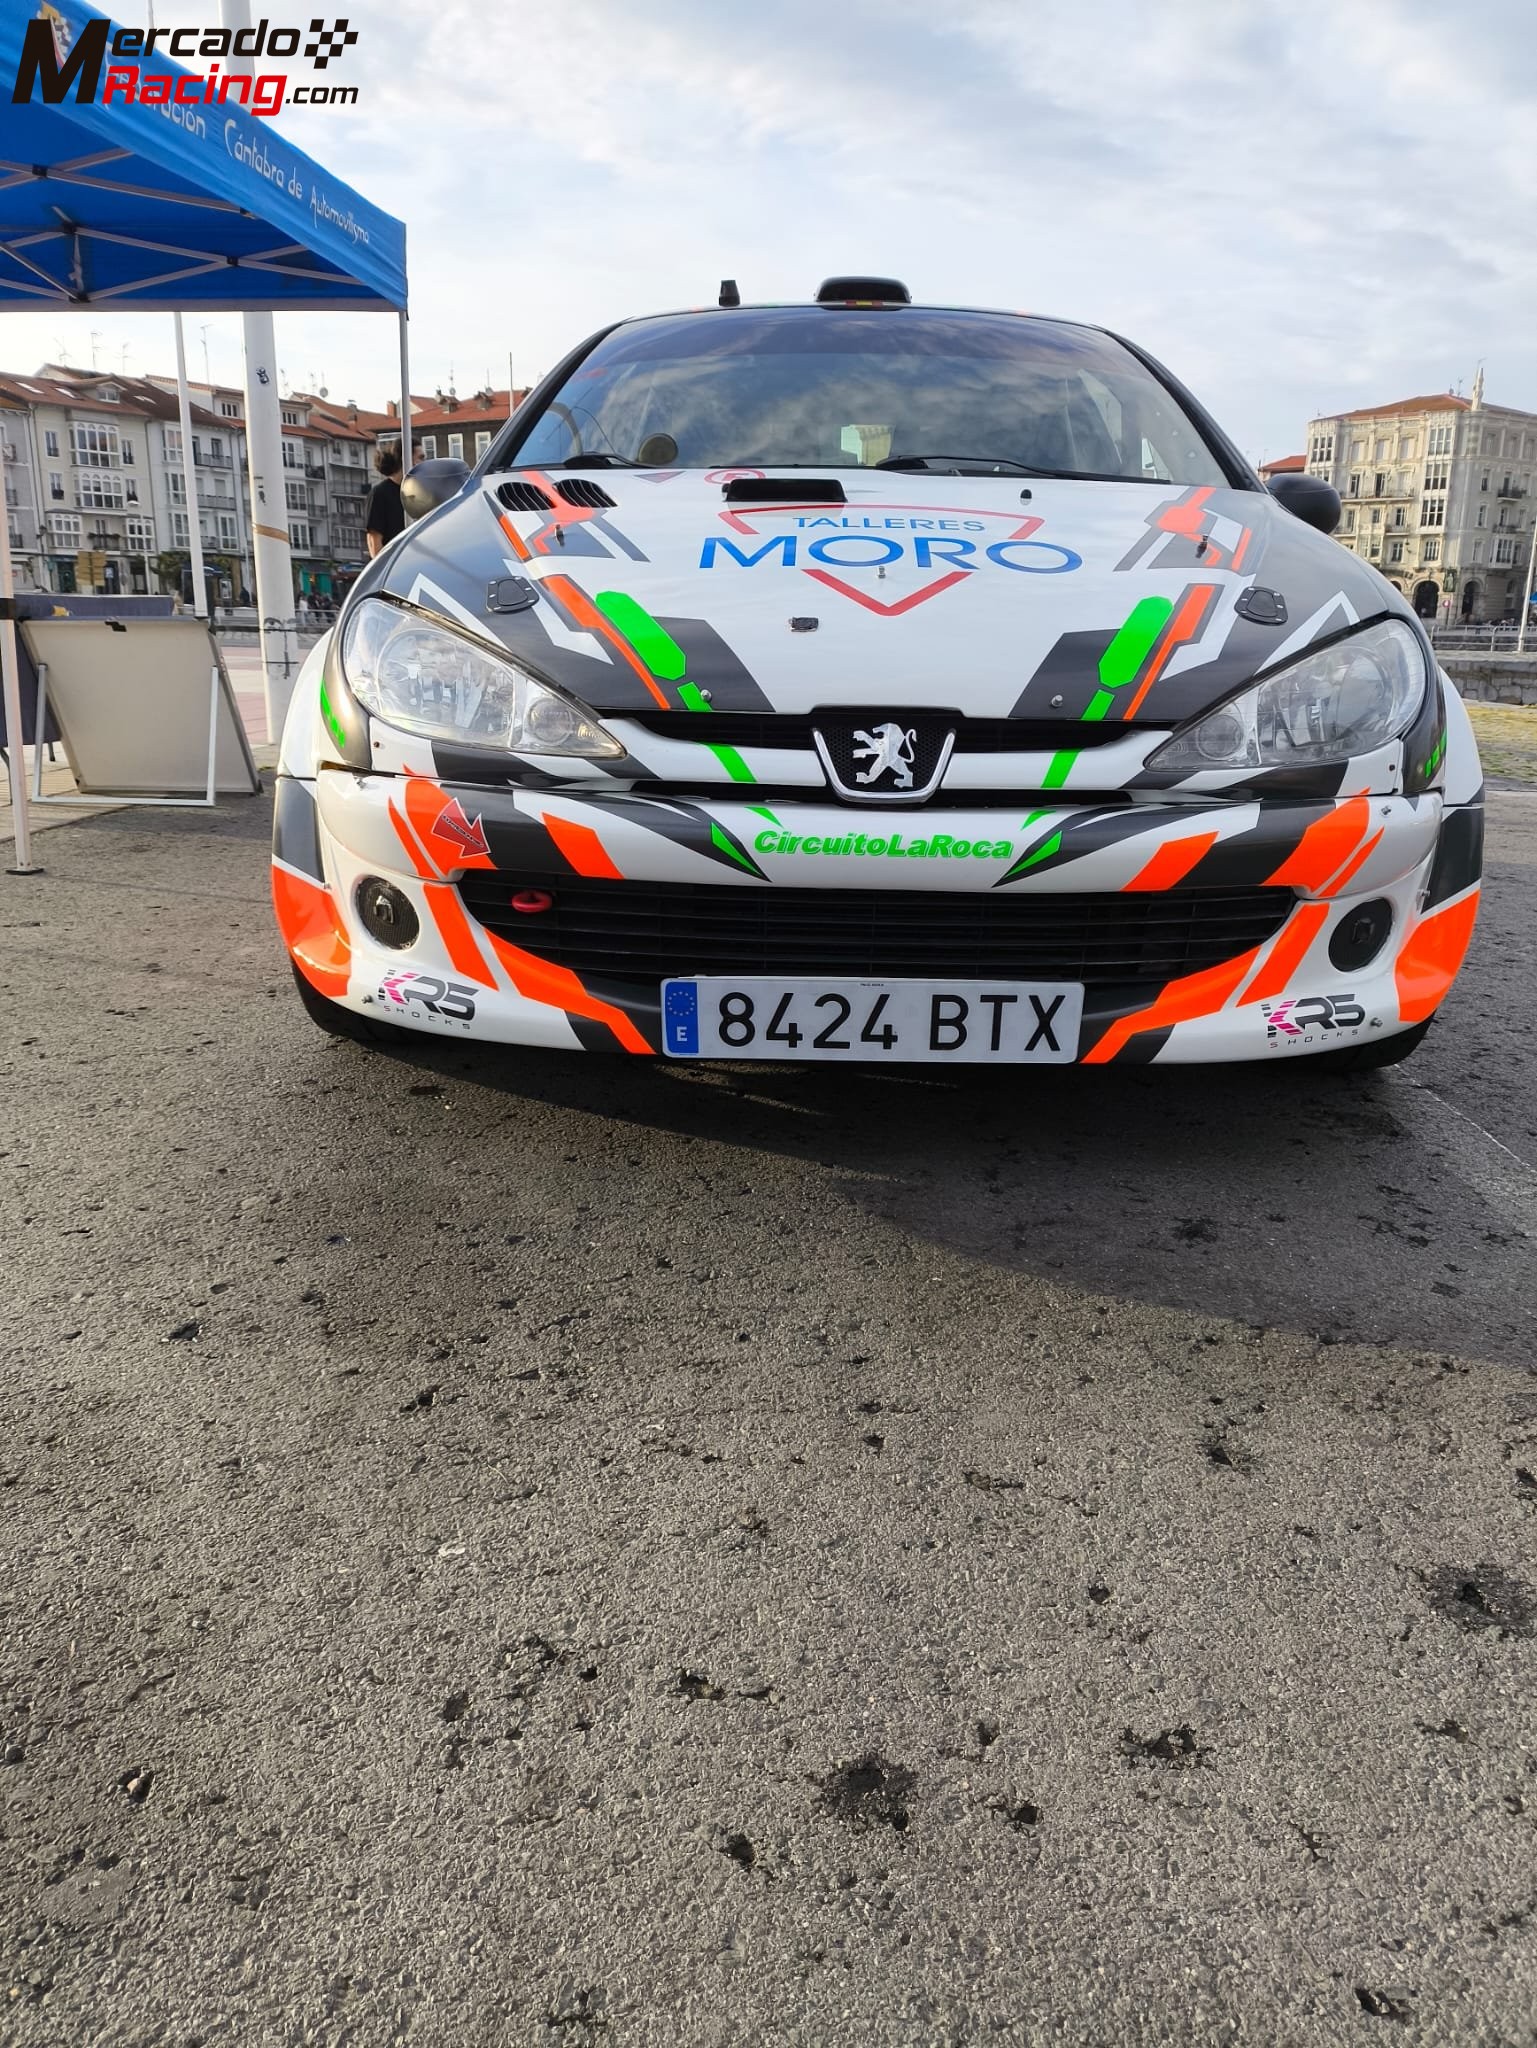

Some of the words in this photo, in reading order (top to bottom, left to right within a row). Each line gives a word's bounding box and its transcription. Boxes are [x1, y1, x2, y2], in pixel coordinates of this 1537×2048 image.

[224, 118, 285, 188] Cántabra
[288, 167, 303, 200] de
[309, 185, 370, 244] Automovilismo
[793, 517, 986, 532] TALLERES
[699, 535, 1083, 574] MORO
[754, 829, 1015, 859] CircuitoLaRoca
[383, 1005, 471, 1030] SHOCKS
[718, 991, 898, 1050] 8424
[929, 994, 1066, 1052] BTX
[676, 1026, 688, 1042] E
[1269, 1029, 1359, 1049] SHOCKS
